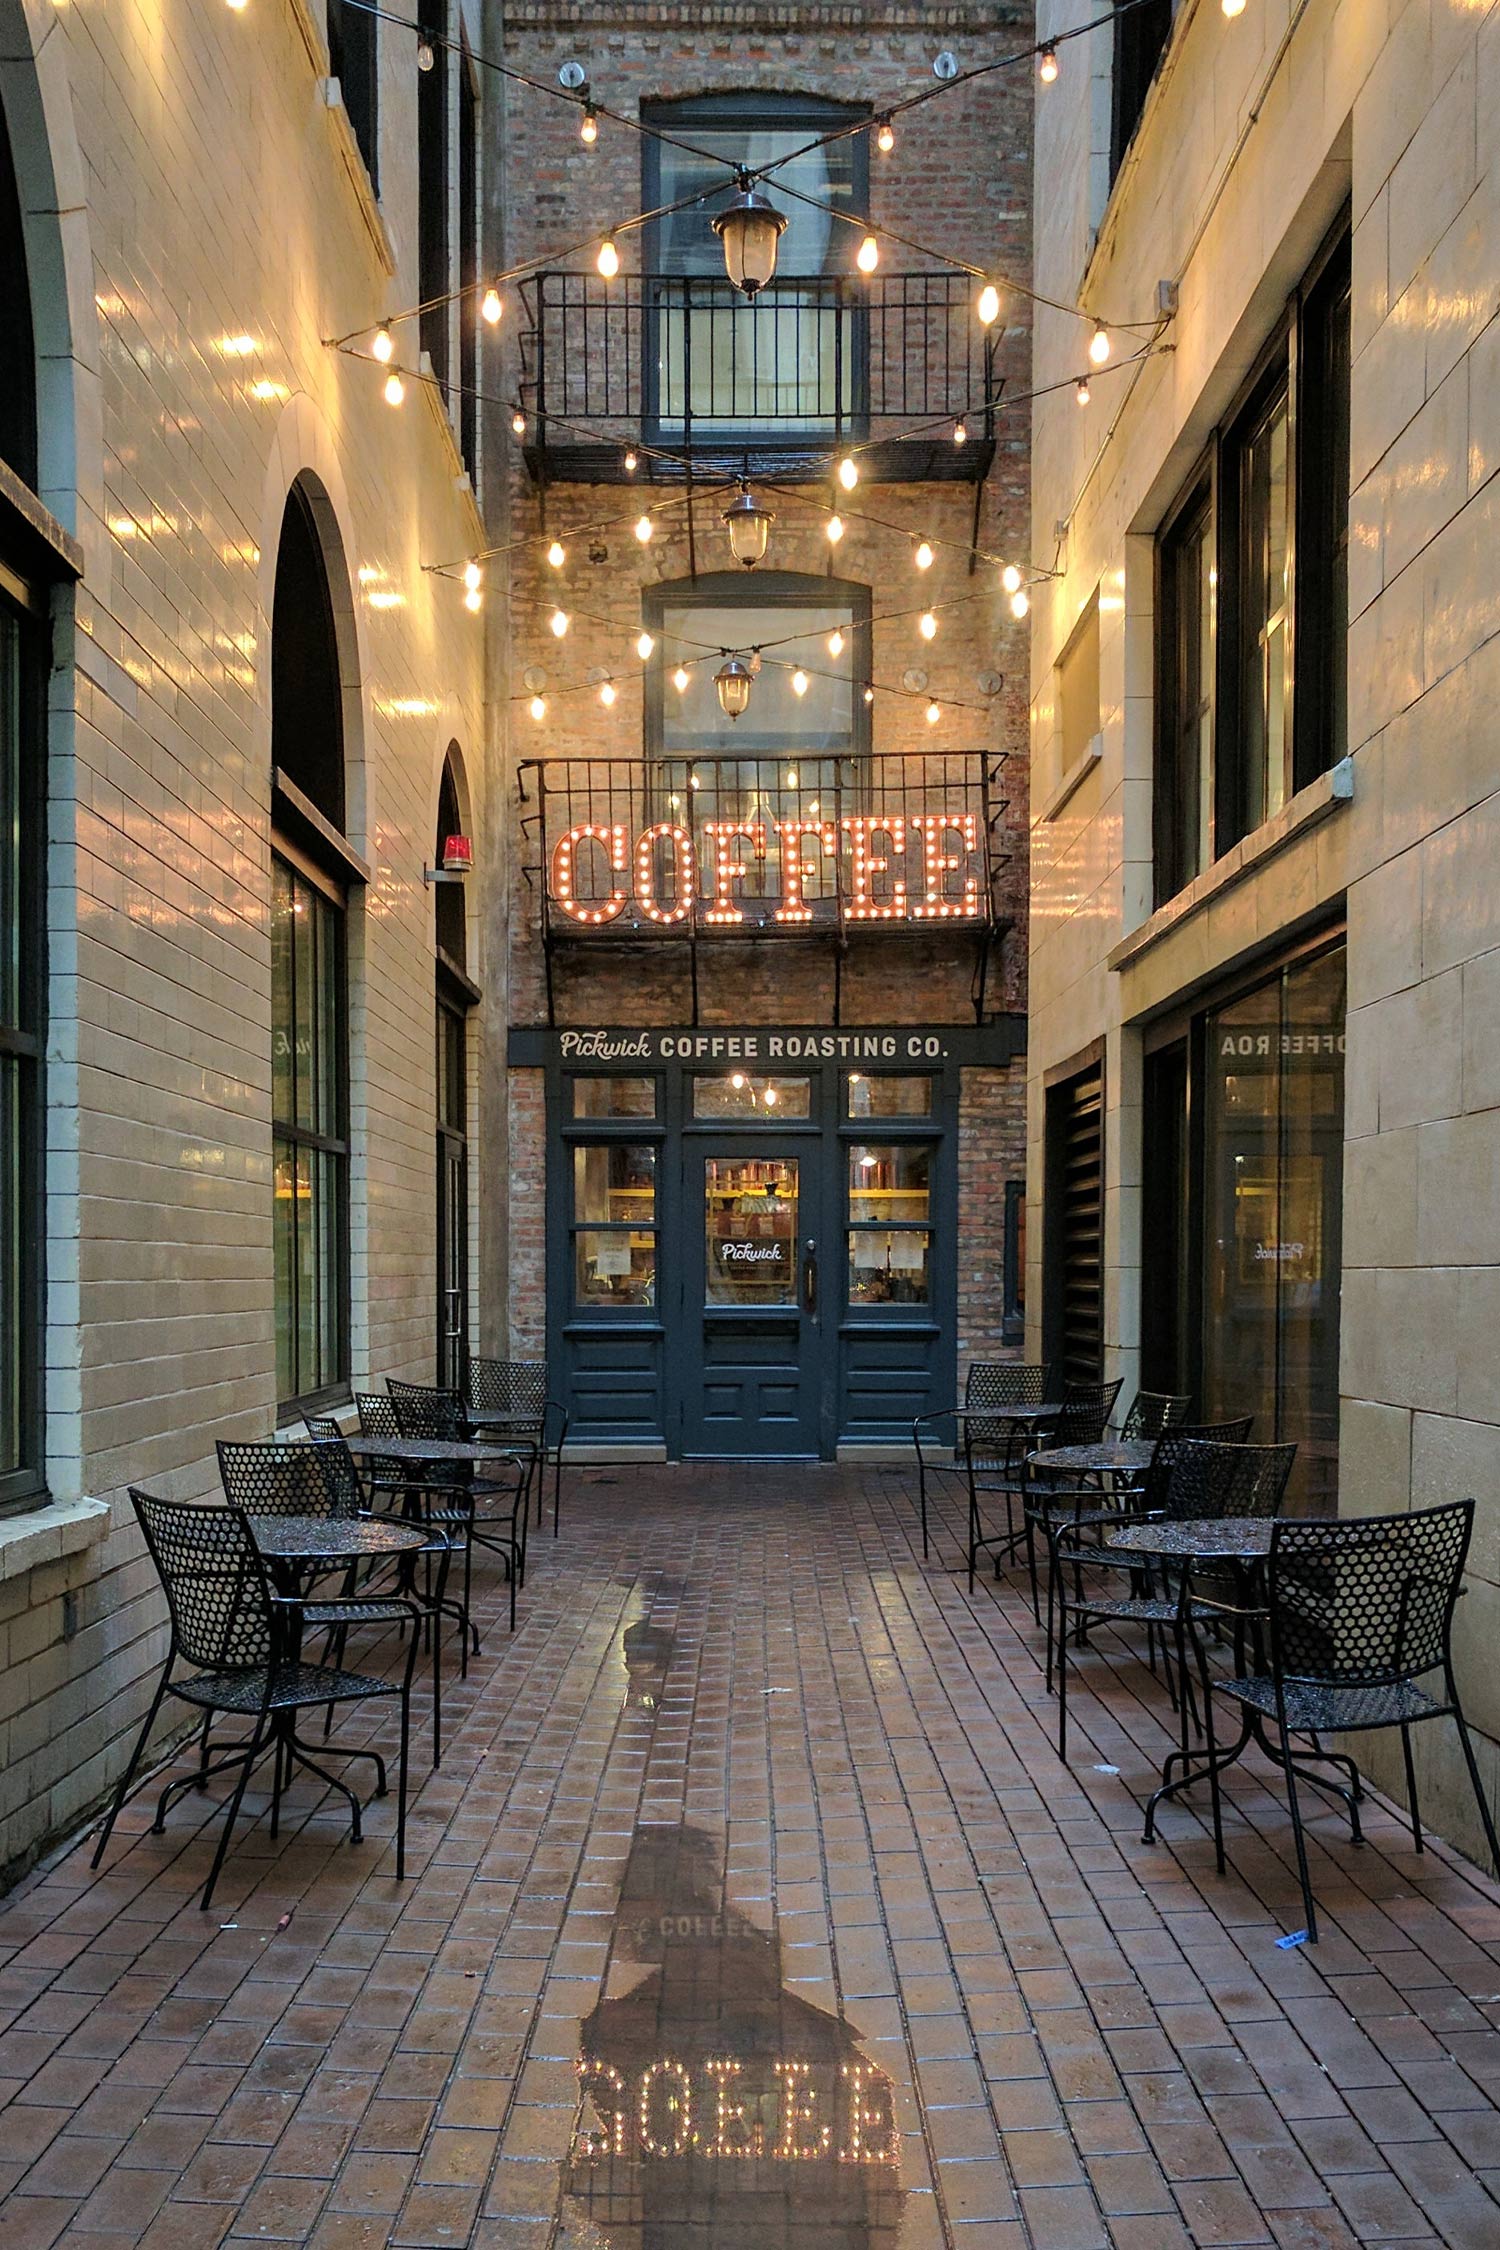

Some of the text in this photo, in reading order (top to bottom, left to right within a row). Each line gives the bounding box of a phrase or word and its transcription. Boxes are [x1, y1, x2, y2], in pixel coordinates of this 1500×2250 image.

[552, 815, 978, 925] COFFEE
[560, 1031, 949, 1060] Pickwick COFFEE ROASTING CO.
[722, 1243, 781, 1262] Pickwick
